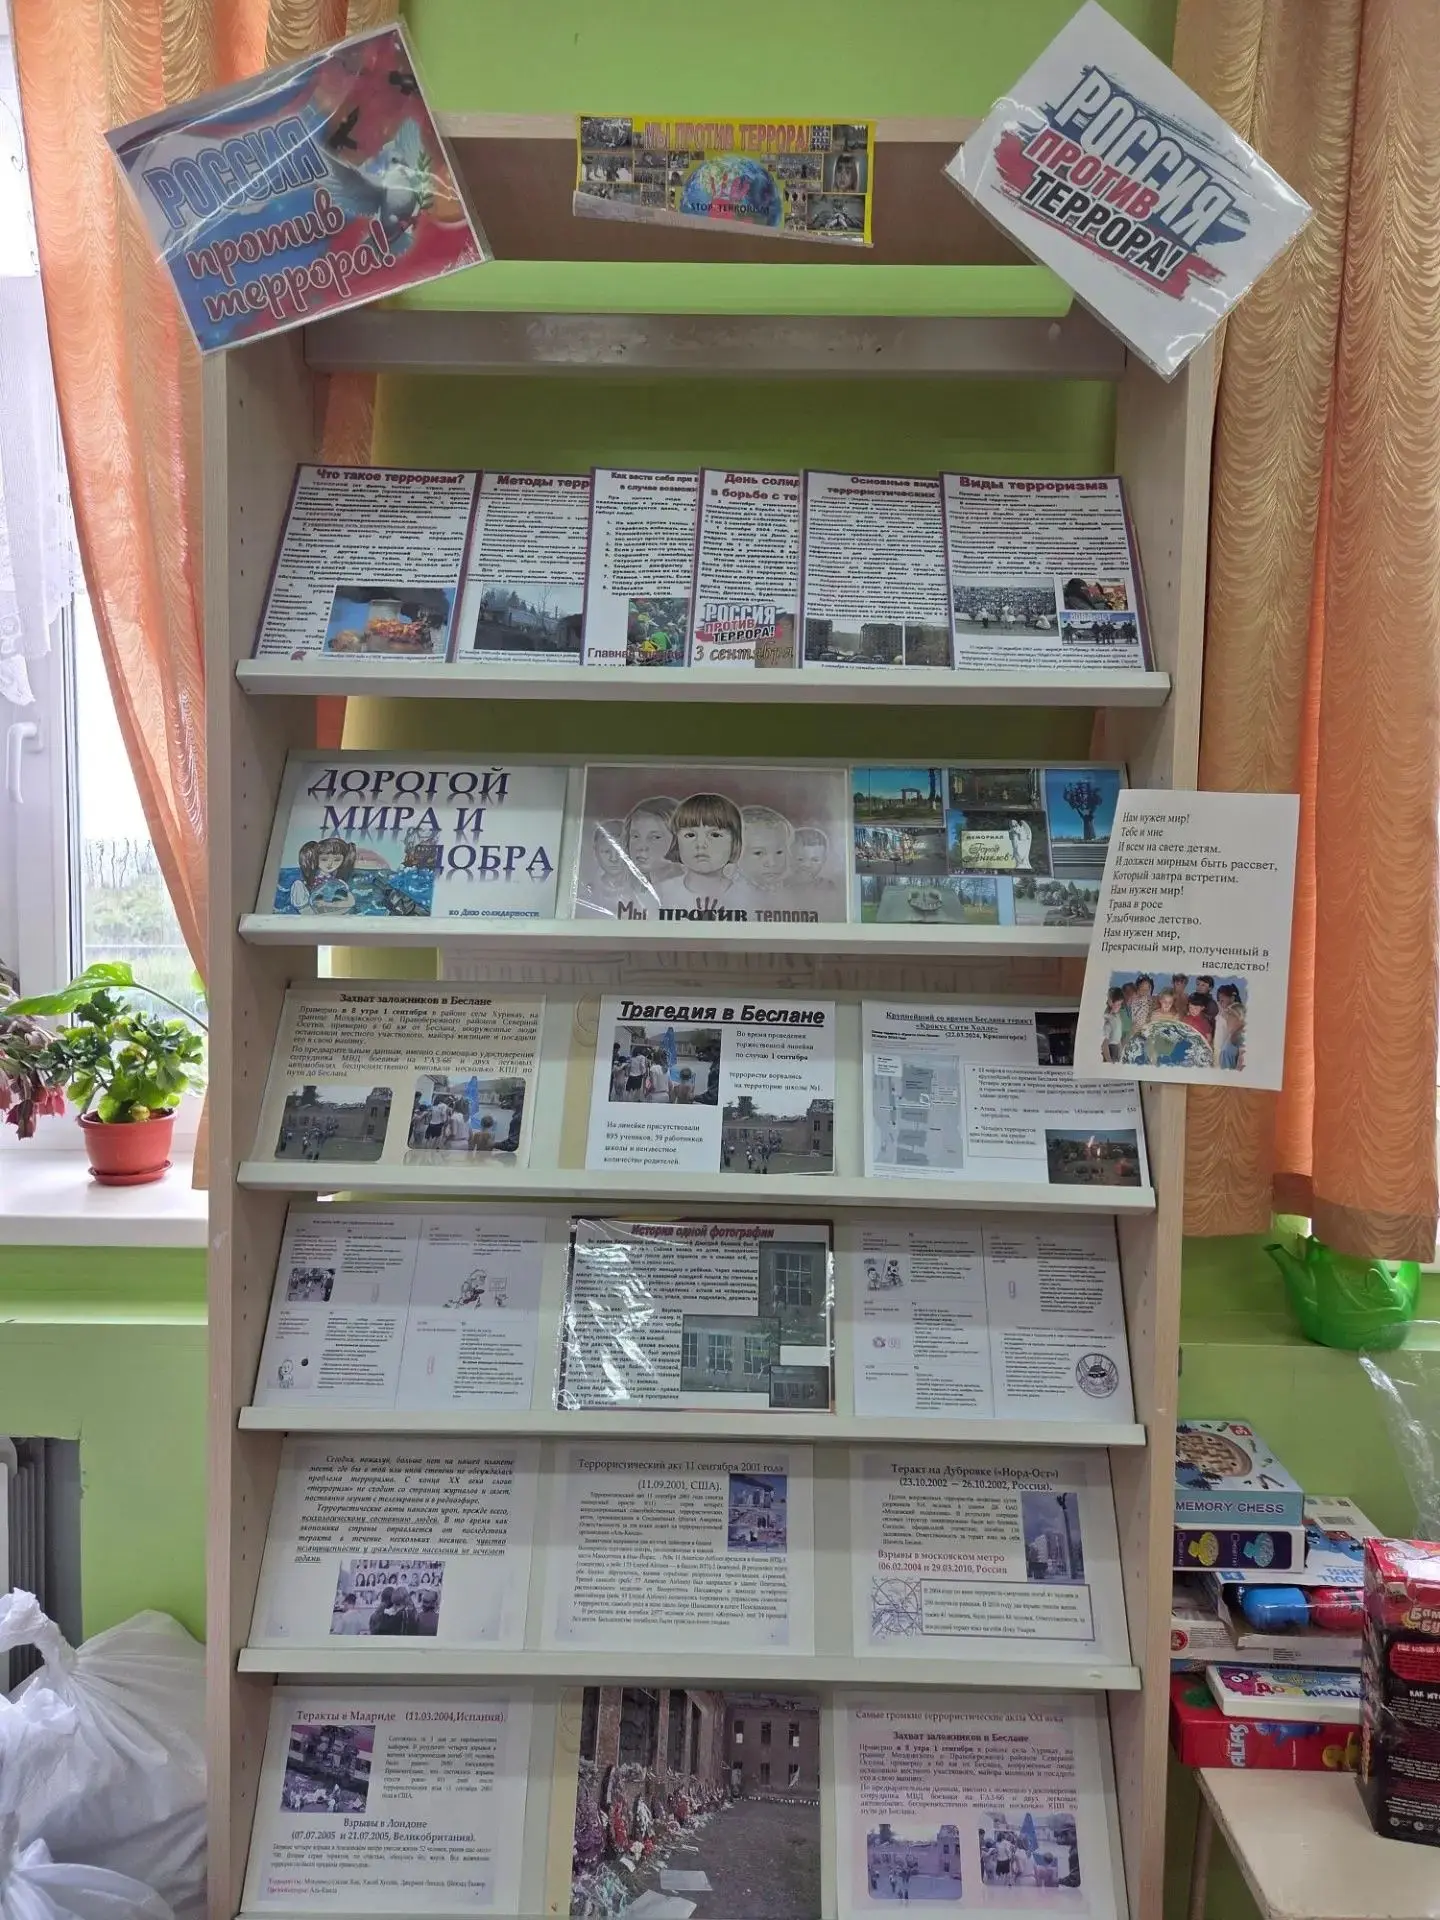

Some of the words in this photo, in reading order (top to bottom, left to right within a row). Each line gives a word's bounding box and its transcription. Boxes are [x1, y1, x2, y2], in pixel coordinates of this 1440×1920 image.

[644, 122, 669, 149] МЫ
[676, 122, 734, 150] ПРОТИВ
[739, 124, 809, 151] ТЕРРОРА!
[1051, 66, 1237, 249] РОССИЯ
[143, 115, 328, 229] РОССИЯ
[1022, 126, 1163, 220] ПРОТИВ
[1022, 169, 1184, 282] ТЕРРОРА!
[186, 188, 345, 285] против
[204, 220, 396, 322] террора!
[317, 467, 340, 479] Что
[342, 468, 381, 480] такое
[384, 469, 464, 484] терроризм?
[497, 473, 553, 487] Методы
[611, 470, 627, 479] Как
[628, 471, 653, 480] вести
[654, 472, 675, 481] себя
[676, 473, 692, 482] при
[724, 473, 758, 484] День
[850, 474, 910, 486] Основные
[959, 474, 1003, 489] Виды
[1007, 475, 1108, 492] терроризма
[711, 488, 718, 496] в
[721, 488, 768, 499] борьбе
[771, 492, 779, 500] с
[828, 488, 935, 498] террористических
[704, 604, 776, 626] РОССИЯ
[704, 620, 755, 633] ПРОТИВ
[713, 626, 774, 641] ТЕРРОРА!
[694, 646, 703, 660] 3
[1123, 812, 1138, 822] Нам
[1139, 814, 1165, 822] нужен
[1167, 814, 1190, 823] мир!
[1121, 826, 1138, 836] Тебе
[1139, 828, 1144, 836] и
[1146, 828, 1163, 836] мне
[1118, 841, 1124, 851] И
[1125, 843, 1144, 851] всем
[1146, 843, 1156, 851] на
[1158, 843, 1184, 852] свете
[1186, 844, 1221, 853] детям.
[1116, 855, 1122, 865] И
[1122, 857, 1154, 866] должен
[1156, 858, 1197, 867] мирным
[1200, 857, 1227, 868] быть
[1230, 861, 1278, 870] рассвет,
[1113, 869, 1148, 881] Который
[1152, 872, 1182, 881] завтра
[1185, 873, 1239, 883] встретим.
[1110, 884, 1126, 894] Нам
[1128, 886, 1157, 894] нужен
[1160, 887, 1184, 895] мир!
[1109, 899, 1131, 908] Трава
[1133, 900, 1138, 908] в
[1140, 900, 1163, 910] росе
[1106, 912, 1155, 923] Улыбчивое
[1158, 915, 1202, 925] детство.
[1104, 927, 1121, 937] Нам
[1122, 928, 1153, 939] нужен
[1156, 930, 1180, 940] мир,
[1101, 941, 1158, 953] Прекрасный
[1161, 944, 1185, 954] мир,
[1188, 945, 1258, 956] полученный
[1262, 949, 1269, 957] в
[1202, 961, 1269, 971] наследство!
